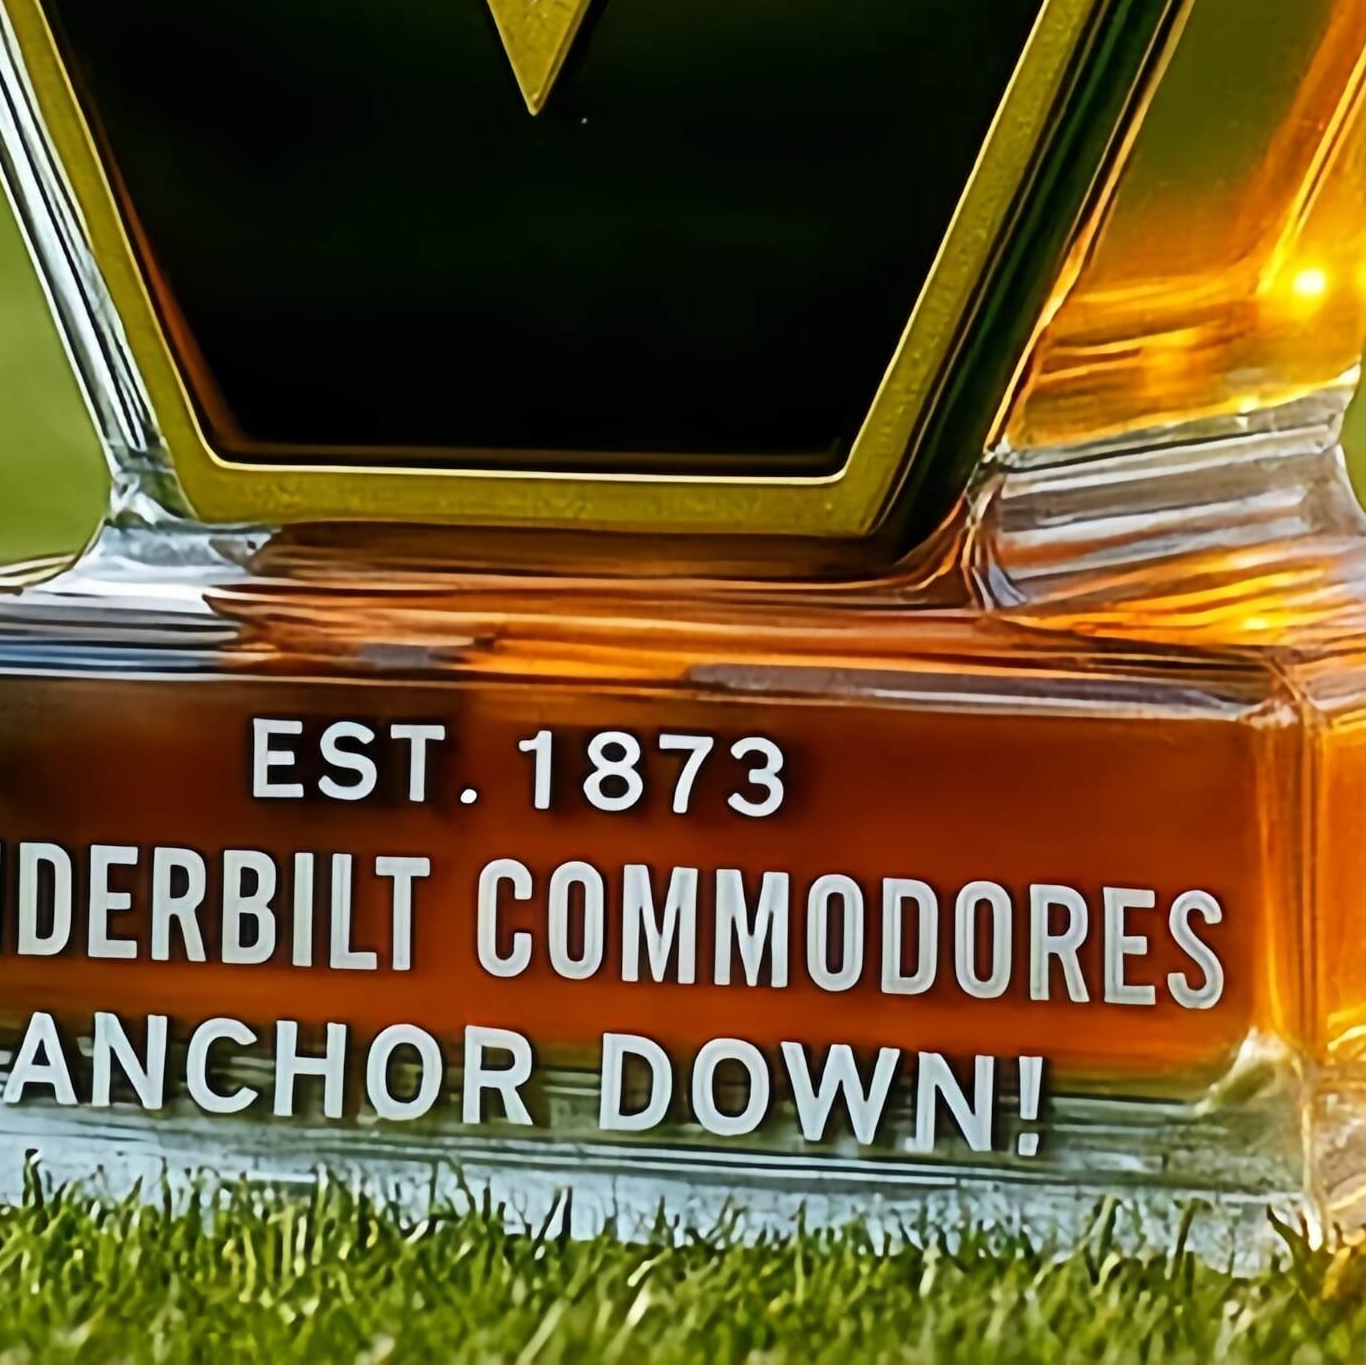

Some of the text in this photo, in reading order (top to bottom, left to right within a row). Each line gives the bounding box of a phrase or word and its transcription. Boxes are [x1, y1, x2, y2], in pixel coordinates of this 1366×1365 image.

[251, 718, 786, 818] EST. 1873
[476, 859, 1225, 1010] COMMODORES
[2, 1013, 1044, 1157] ANCHOR DOWN!
